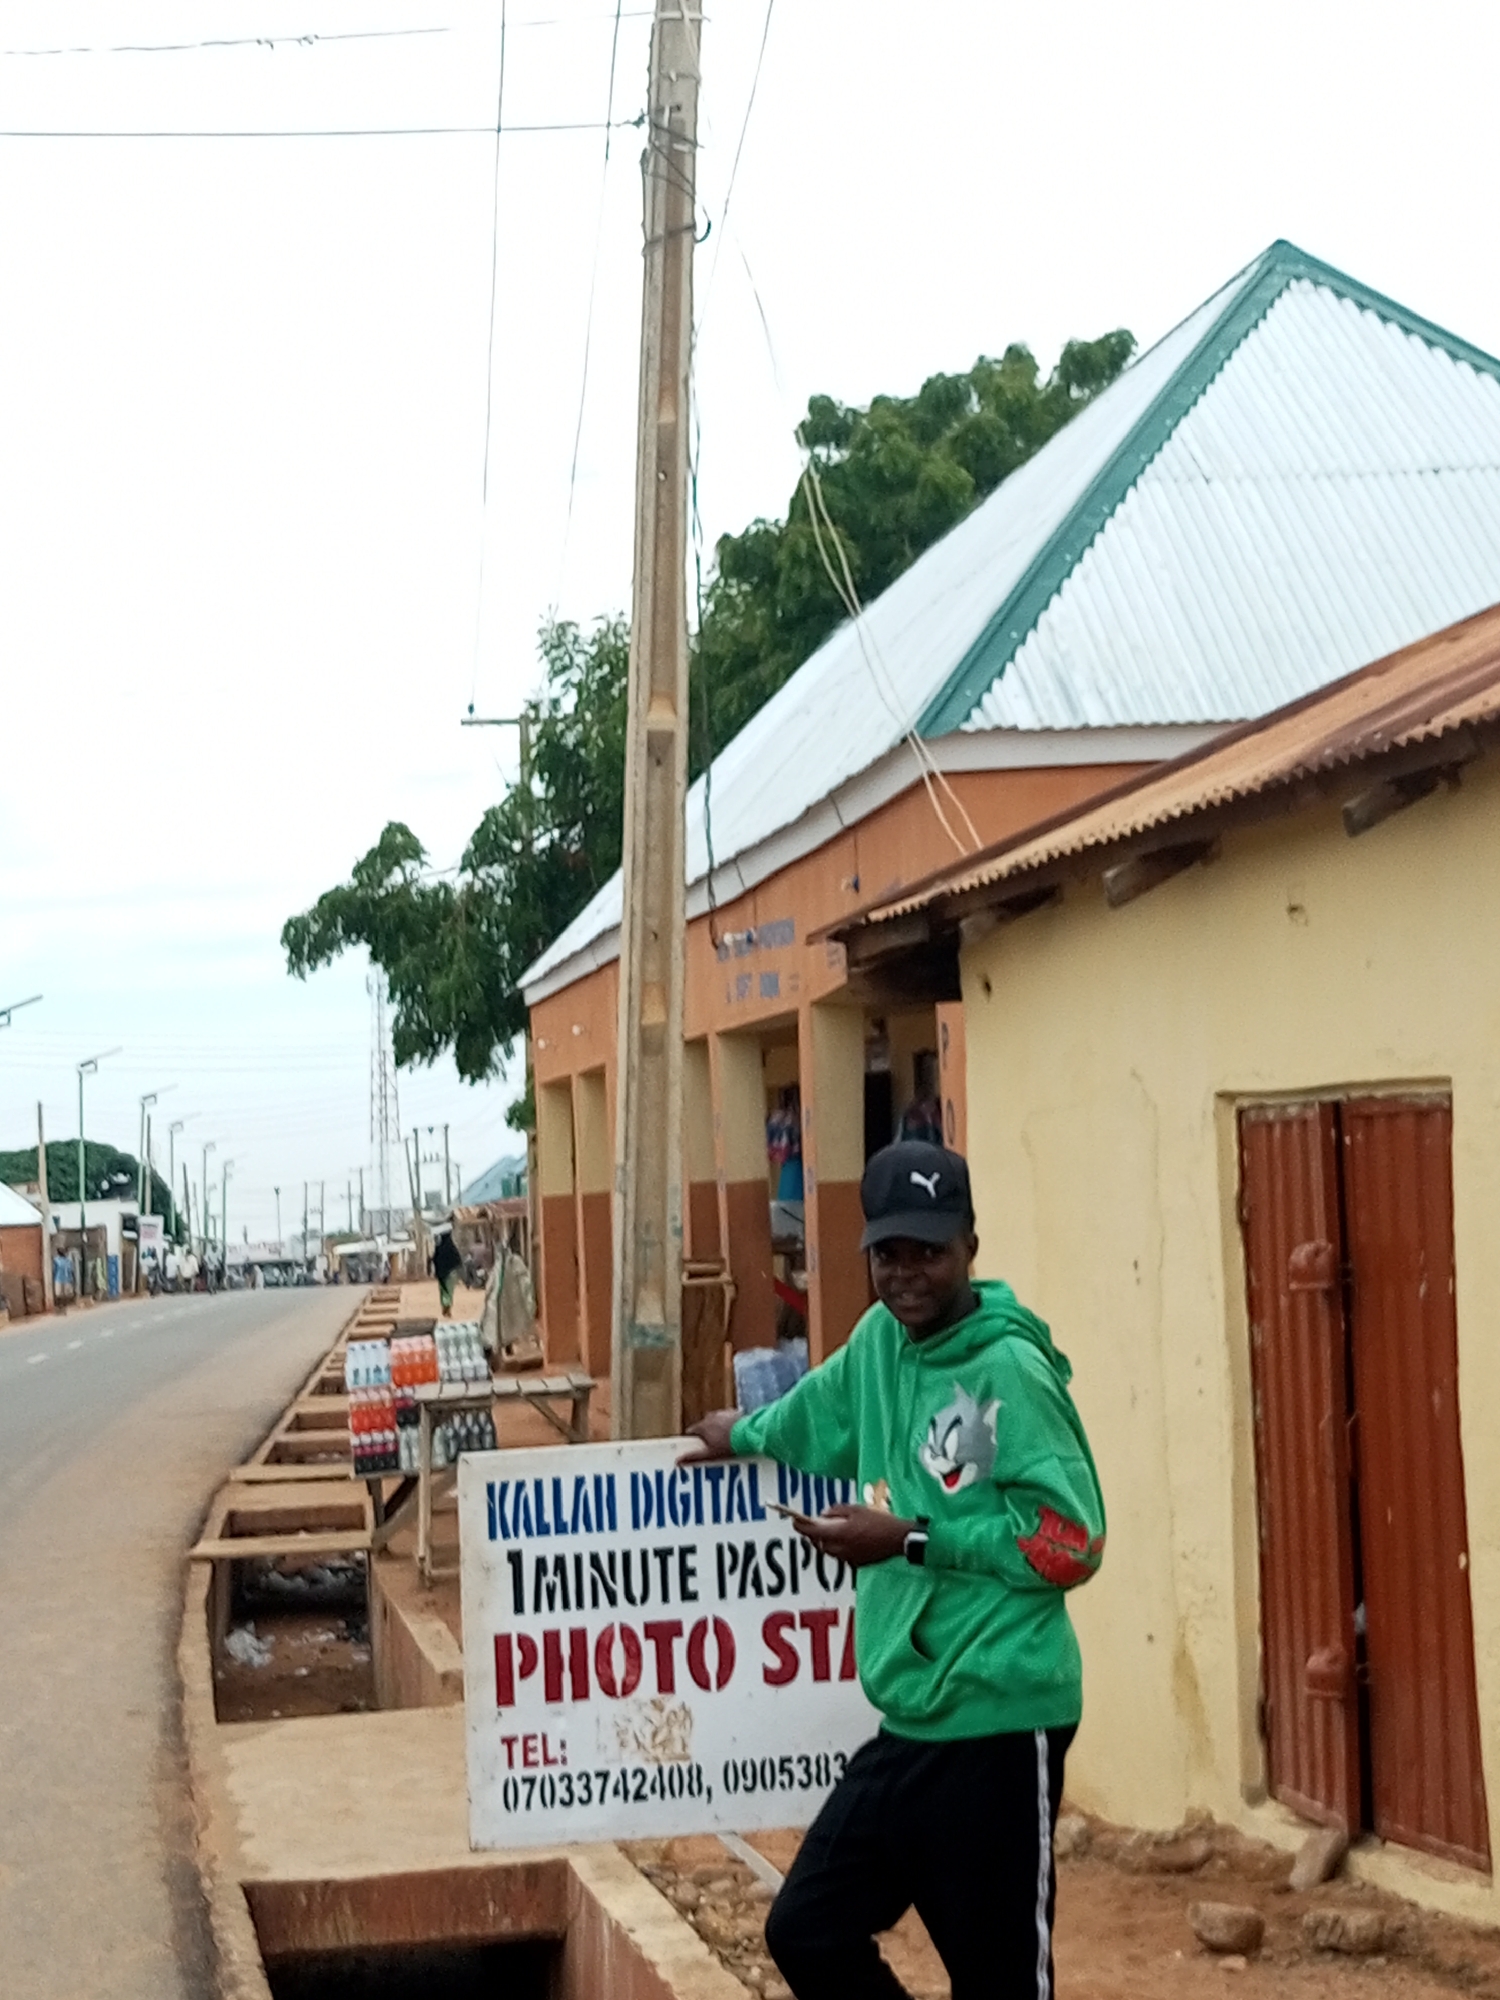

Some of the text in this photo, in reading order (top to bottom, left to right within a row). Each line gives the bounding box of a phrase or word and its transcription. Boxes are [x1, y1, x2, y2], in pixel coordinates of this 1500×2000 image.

[486, 1473, 617, 1541] KALLAH
[630, 1462, 767, 1531] DIGITAL
[715, 1536, 857, 1600] PASPO
[494, 1614, 737, 1708] PHOTO
[501, 1731, 569, 1770] TEL:
[502, 1761, 713, 1813] 07033742408,
